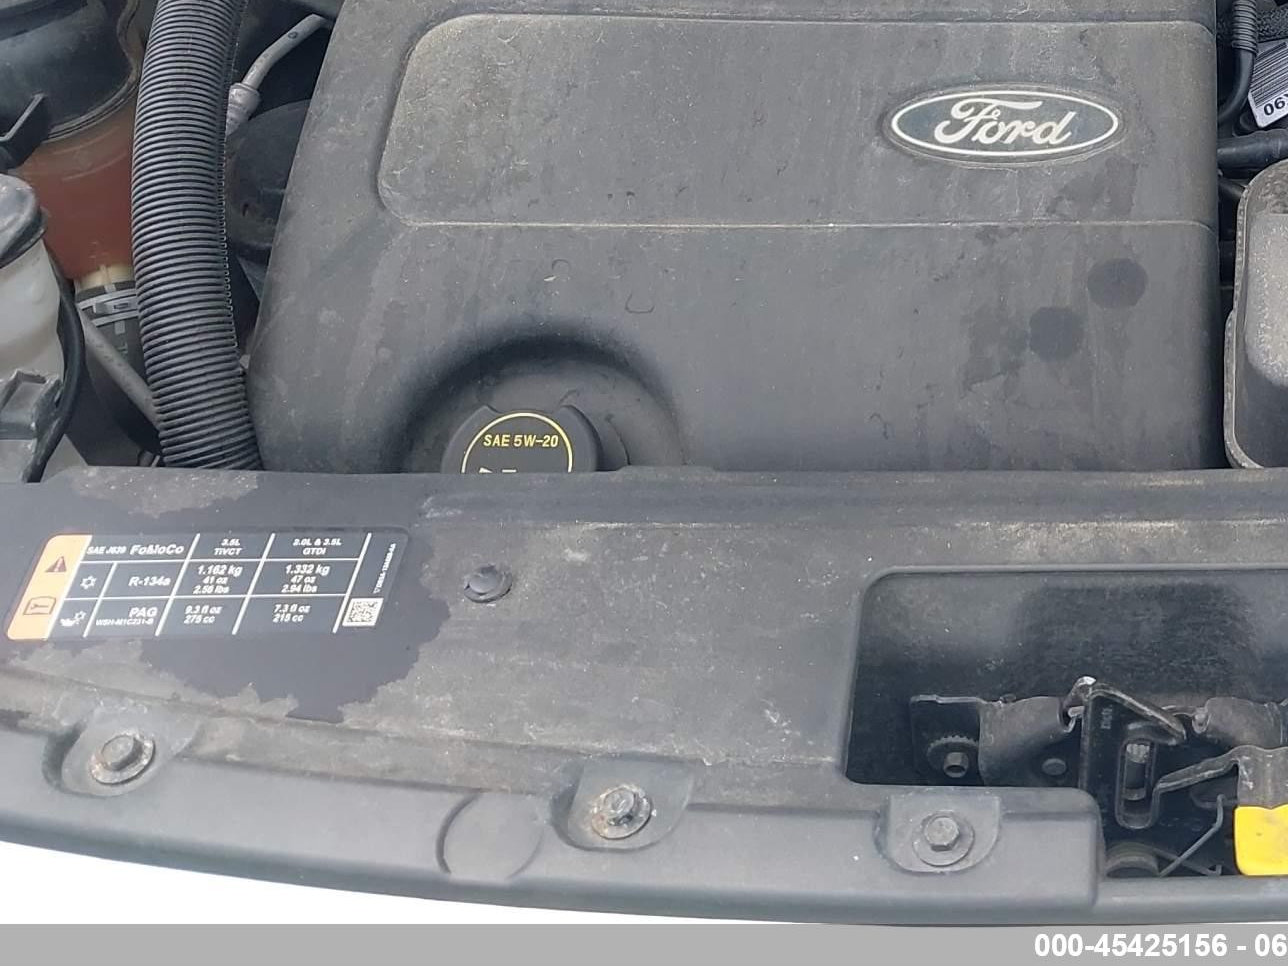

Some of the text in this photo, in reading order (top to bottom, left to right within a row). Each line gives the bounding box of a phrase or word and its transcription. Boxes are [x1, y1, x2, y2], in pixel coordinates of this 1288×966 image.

[934, 98, 1077, 145] Ford
[483, 434, 559, 448] SAE 5W-20
[130, 544, 184, 555] FoMoCo
[228, 565, 243, 577] kg
[285, 564, 331, 577] 1.332 kg
[128, 576, 172, 587] R-134a
[216, 577, 229, 585] oz
[291, 575, 317, 584] 47 oz
[215, 585, 230, 594] lbs
[303, 584, 318, 593] lbs
[129, 607, 158, 618] PAG
[209, 606, 223, 614] oz
[298, 605, 312, 613] oz
[203, 616, 216, 624] cc
[292, 614, 304, 623] cc
